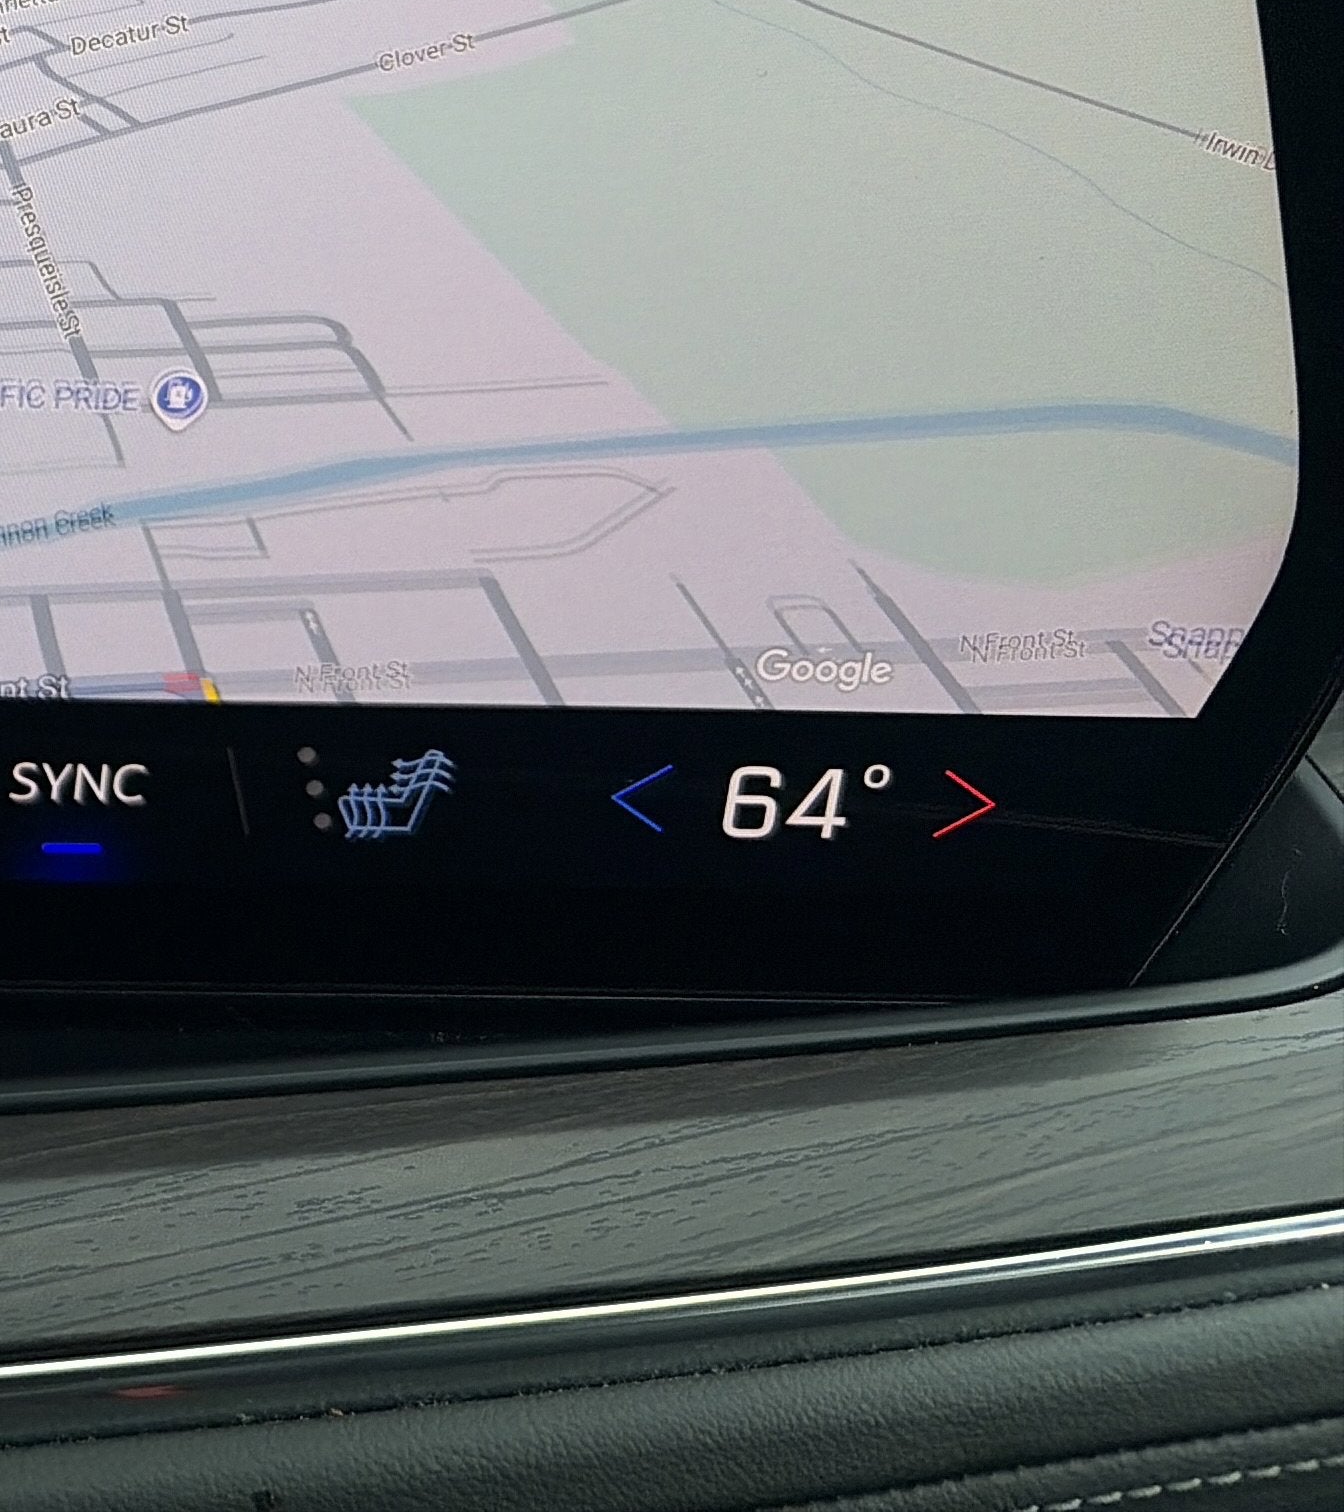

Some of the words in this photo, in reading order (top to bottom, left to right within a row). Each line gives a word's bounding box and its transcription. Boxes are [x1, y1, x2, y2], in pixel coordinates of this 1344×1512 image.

[70, 22, 160, 57] Decatur
[164, 14, 190, 35] St
[378, 41, 447, 73] Clover
[450, 33, 476, 53] St
[55, 96, 81, 120] St
[54, 380, 141, 413] PRIDE
[52, 502, 118, 542] Creek
[34, 674, 71, 700] St
[756, 647, 894, 694] Google
[7, 761, 150, 807] SYNC
[721, 763, 893, 842] 64°
